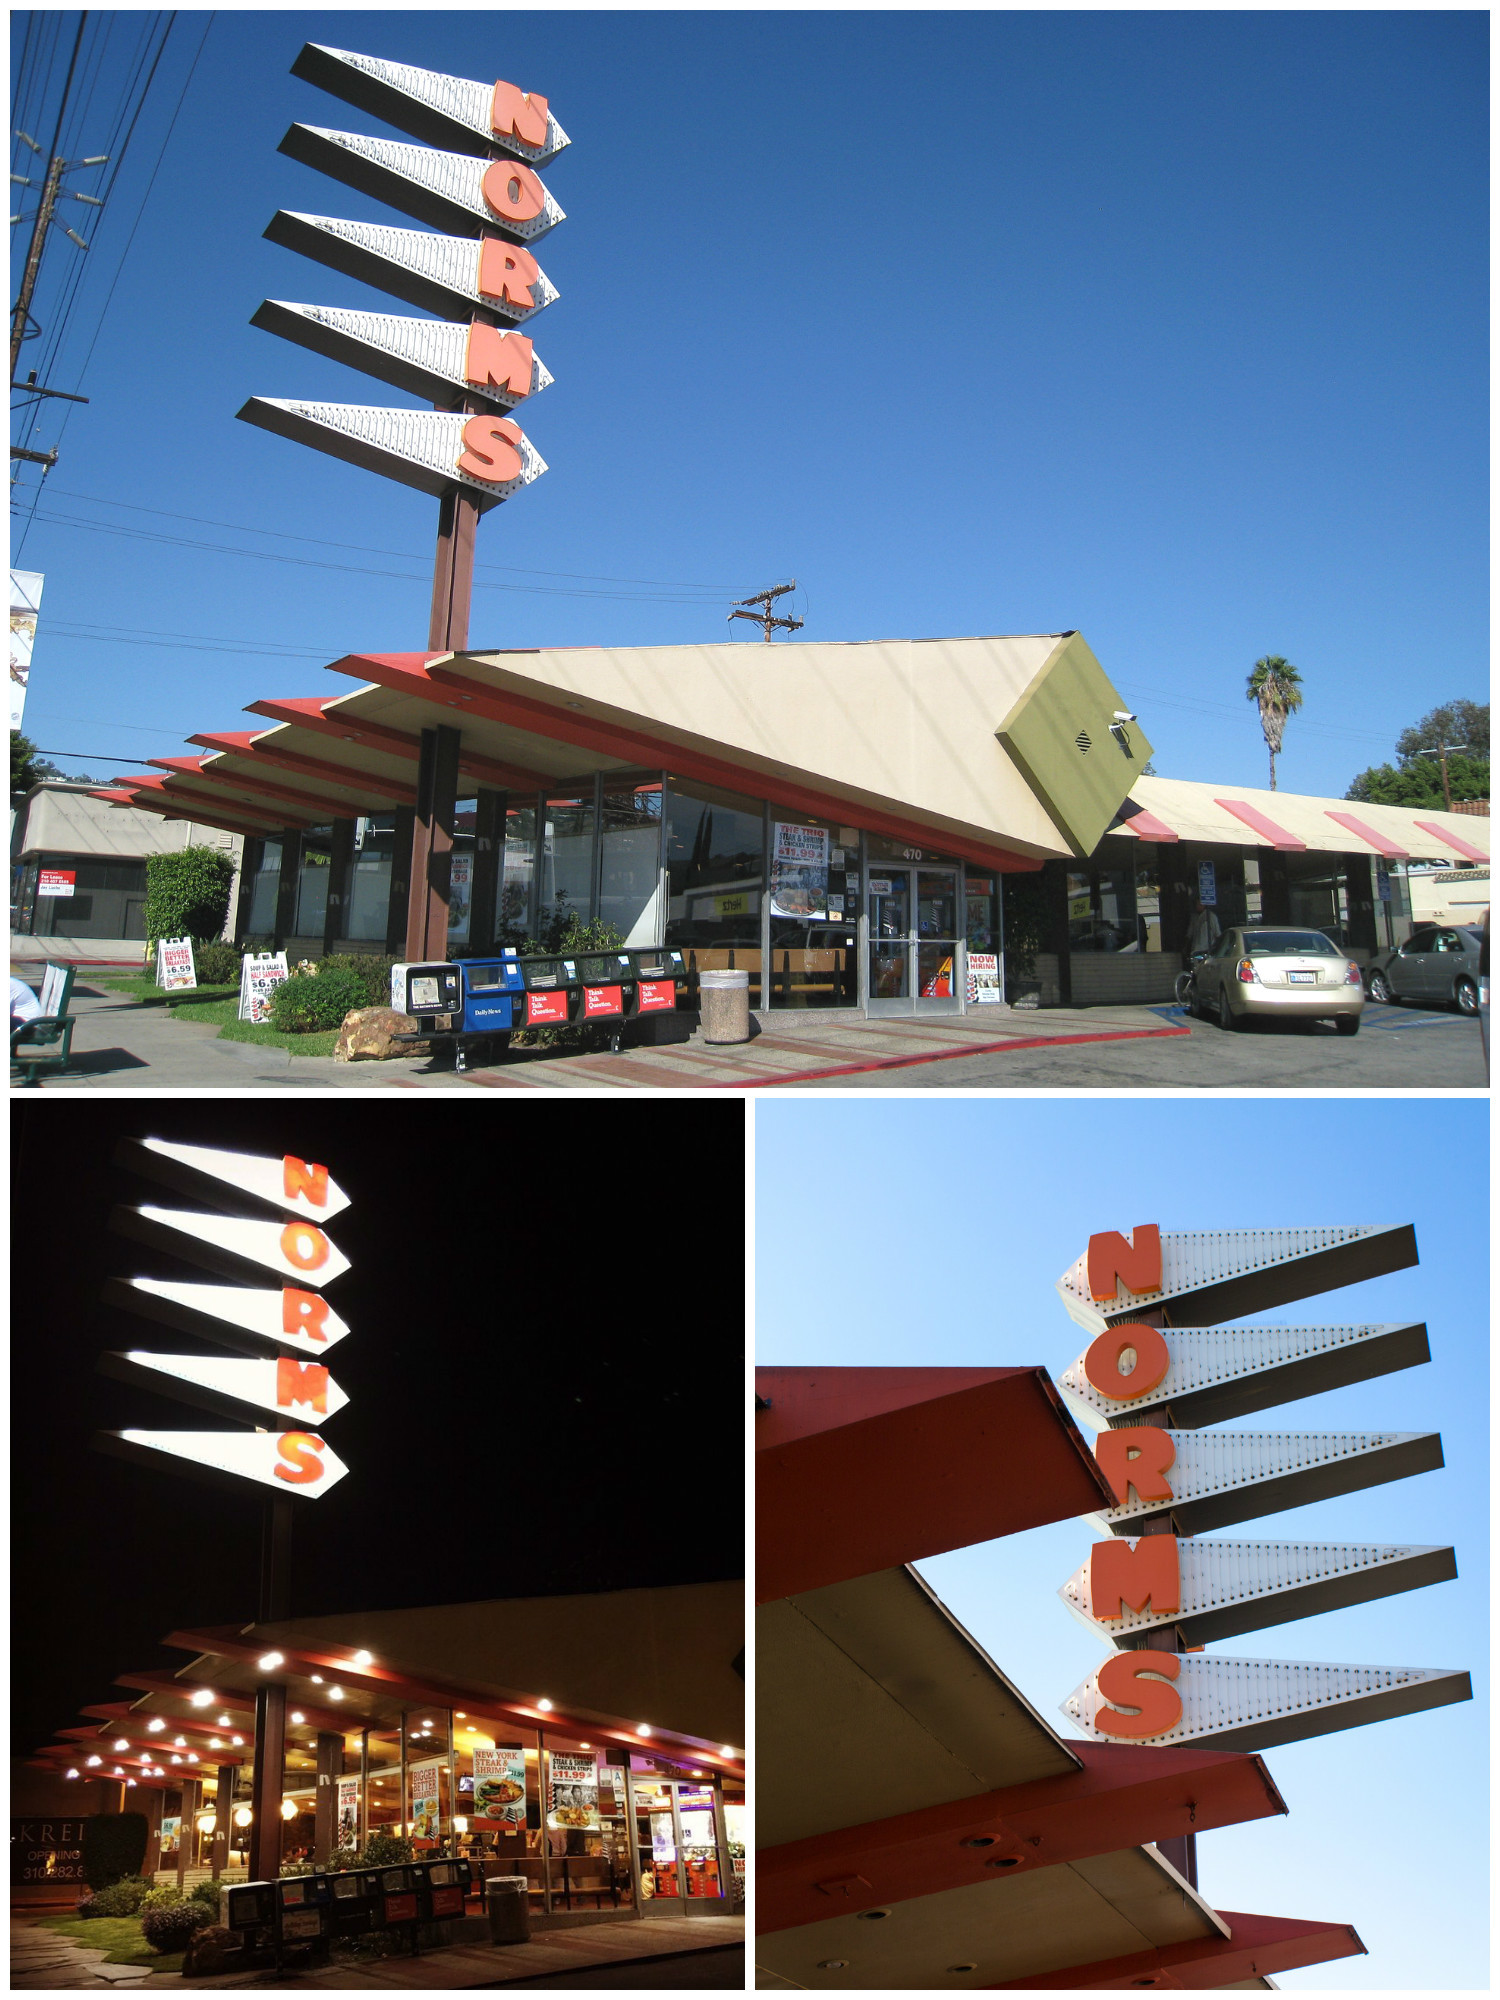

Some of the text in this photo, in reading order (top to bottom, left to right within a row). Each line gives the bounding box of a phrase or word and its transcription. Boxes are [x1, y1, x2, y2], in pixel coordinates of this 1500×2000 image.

[456, 79, 550, 483] NORMS
[780, 824, 825, 838] THE TRIO
[902, 848, 922, 860] 470
[970, 956, 995, 964] NOW
[167, 965, 191, 973] $6.59
[273, 1154, 330, 1485] NORMS
[1085, 1223, 1183, 1739] NORMS
[475, 1750, 494, 1759] NEW
[414, 1768, 436, 1782] BIGGER
[476, 1766, 507, 1774] SHRIMP
[319, 1774, 330, 1786] n
[615, 1772, 621, 1780] A
[414, 1780, 436, 1792] BETTER
[182, 1824, 190, 1833] n
[216, 1831, 225, 1840] n
[28, 1850, 80, 1861] OPENING
